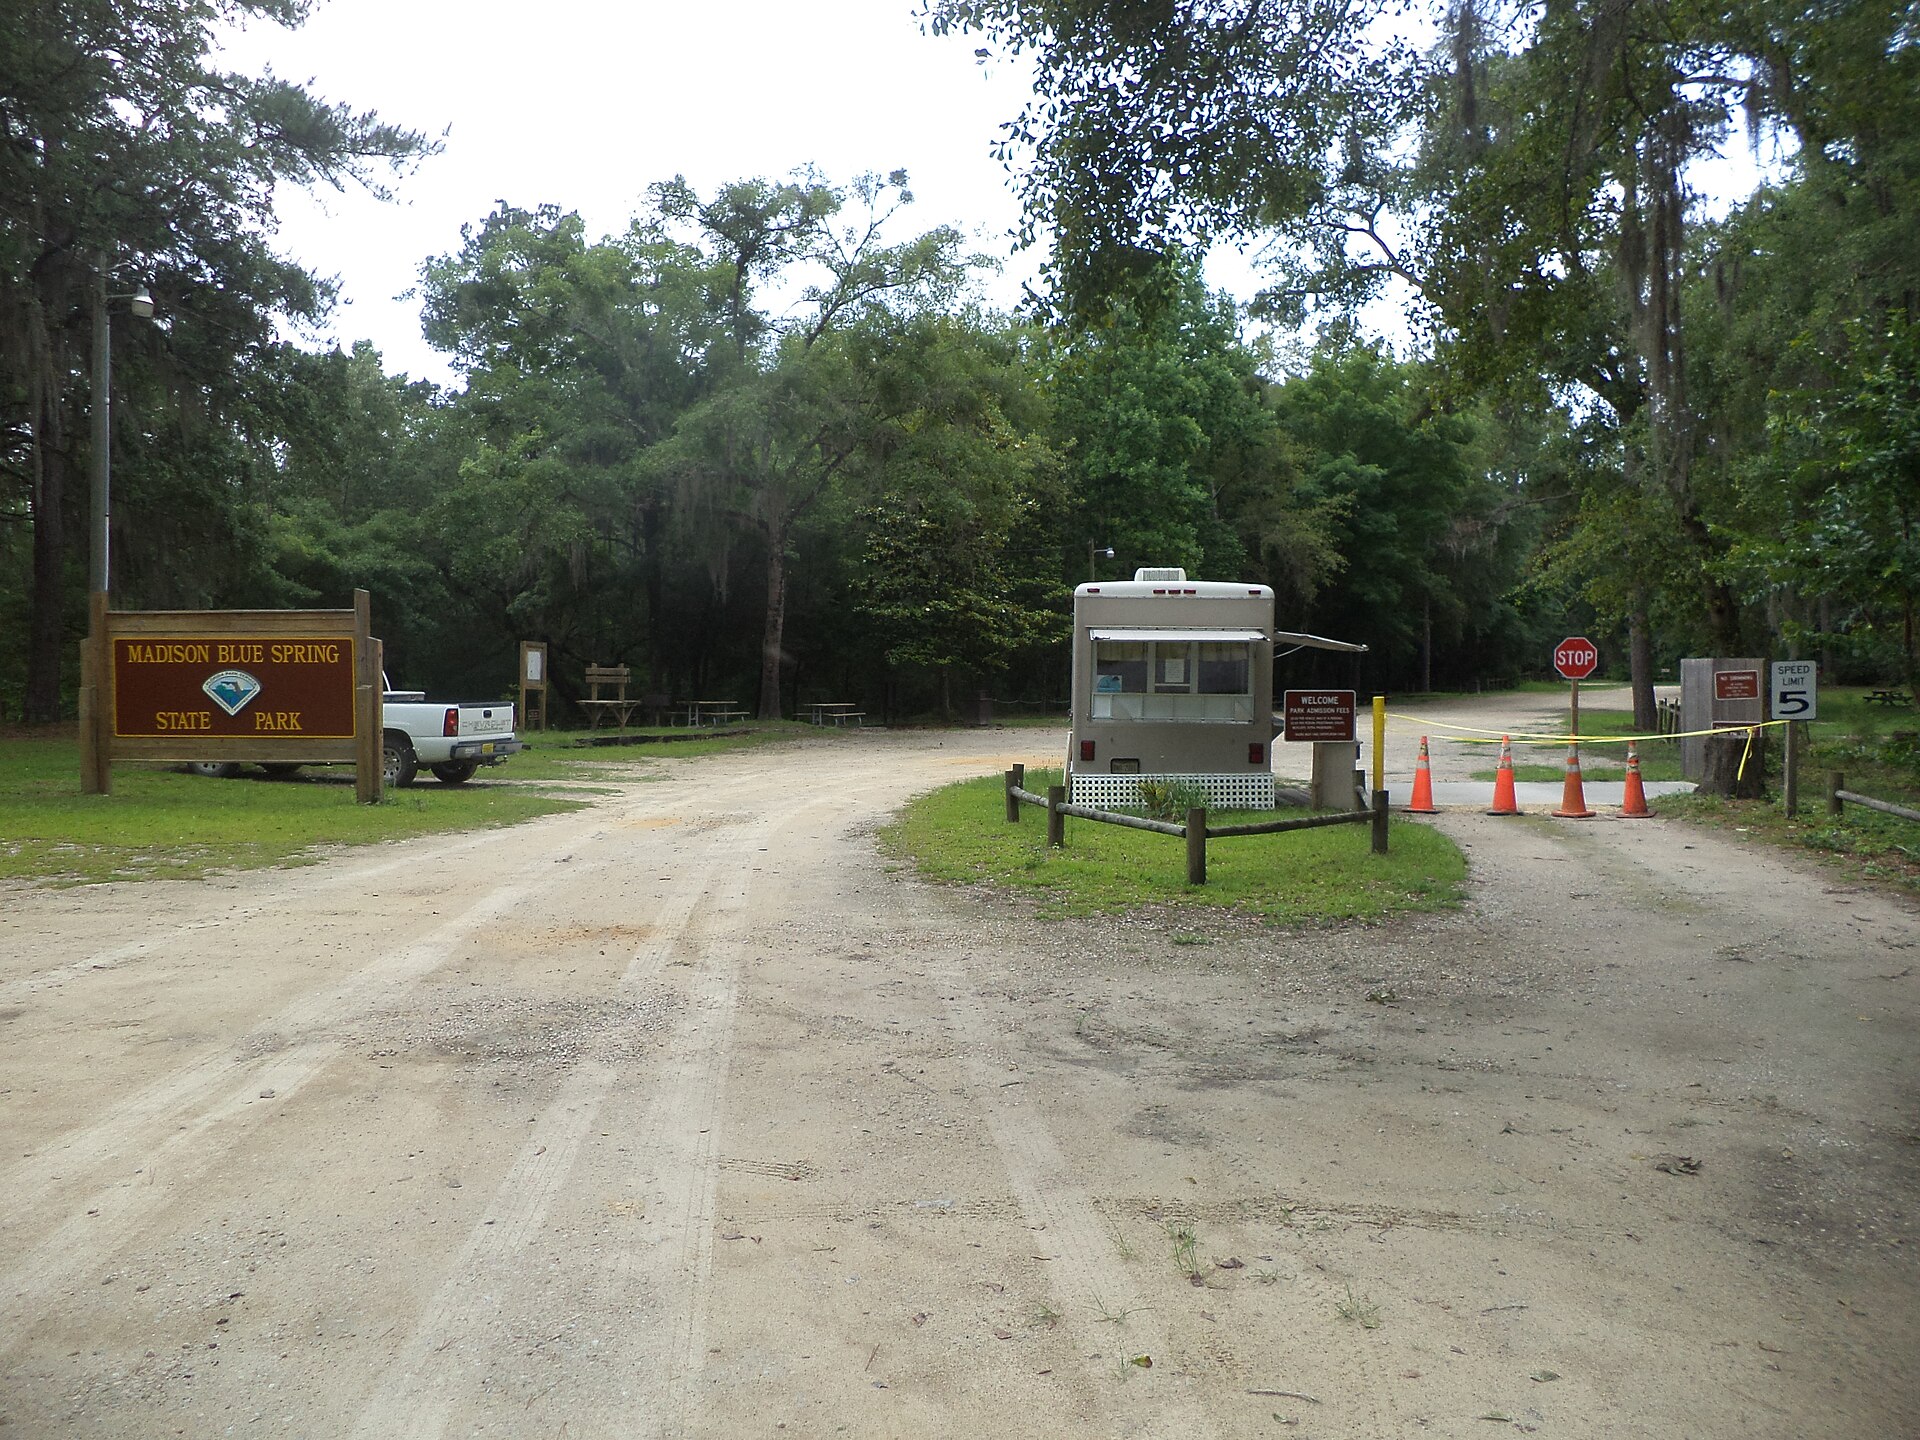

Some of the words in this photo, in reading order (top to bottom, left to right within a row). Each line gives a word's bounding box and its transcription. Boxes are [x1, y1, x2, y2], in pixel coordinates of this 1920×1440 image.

[128, 645, 209, 663] MADISON
[217, 645, 264, 663] BLUE
[271, 645, 340, 663] SPRING
[1557, 650, 1594, 666] STOP
[1778, 665, 1810, 675] SPEED
[1782, 677, 1805, 686] LIMIT
[1301, 696, 1339, 705] WELCOME
[1779, 690, 1810, 715] 5
[156, 711, 212, 730] STATE
[255, 711, 303, 730] PARK
[461, 719, 511, 729] CHEVROLET
